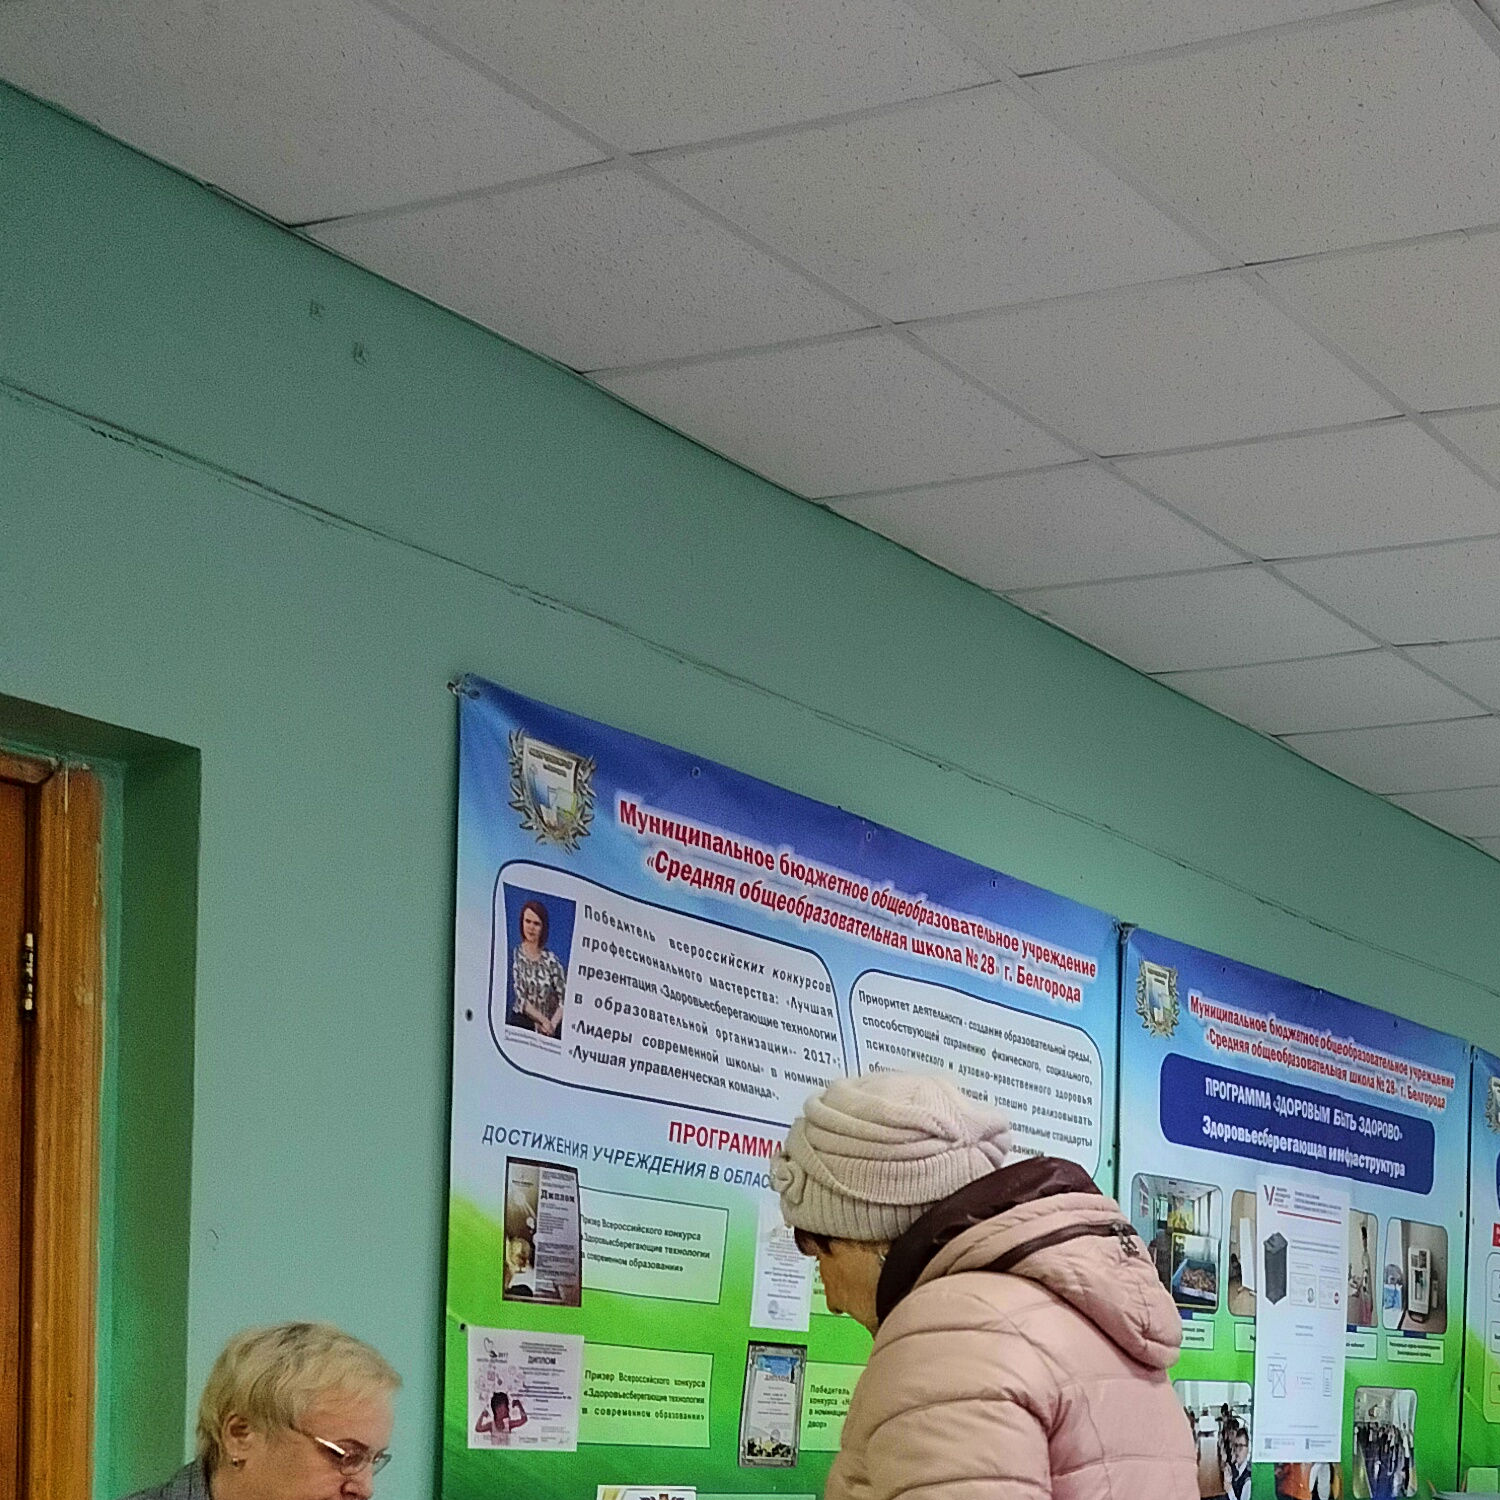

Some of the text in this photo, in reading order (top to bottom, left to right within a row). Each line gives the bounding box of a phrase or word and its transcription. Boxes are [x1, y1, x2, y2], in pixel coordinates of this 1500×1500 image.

[620, 799, 1096, 977] Муниципальное бюджетное общеобразовательное учреждение
[584, 904, 832, 993] Победитель всероссийских конкурсов
[646, 850, 735, 895] «Средняя
[739, 880, 908, 950] общеобразовательная
[911, 937, 962, 964] школа
[965, 946, 979, 970] №
[1003, 966, 1014, 982] г.
[1016, 966, 1082, 1003] Белгорода
[578, 963, 838, 1042] презентация «Здоровьесберегающие технологии
[582, 936, 834, 1018] профессионального мастерства: «Лучшая
[574, 993, 583, 1004] в
[594, 997, 708, 1035] образовательной
[858, 989, 911, 1012] Приоритет
[912, 1005, 963, 1027] деятельности
[968, 1020, 1003, 1040] создание
[1003, 1030, 1066, 1057] образовательной
[1067, 1049, 1093, 1065] среды,
[1190, 995, 1455, 1089] Муниципальное бюджетное общеобразовательное учреждение
[568, 1045, 626, 1069] «Лучшая
[629, 1060, 726, 1088] управленческая
[571, 1019, 633, 1044] «Лидеры
[642, 1035, 719, 1064] современной
[770, 1067, 778, 1078] в
[862, 1016, 1093, 1086] способствующей сохранению физического, социального,
[865, 1038, 945, 1069] психологического
[958, 1063, 1052, 1098] духовно-нравственного
[1055, 1087, 1093, 1106] здоровья
[1251, 1040, 1347, 1082] общеобразовательная
[1349, 1071, 1375, 1089] школа
[1407, 1085, 1446, 1110] Белгорода
[994, 1094, 1028, 1113] успешно
[1031, 1104, 1093, 1127] реализовывать
[1205, 1077, 1272, 1111] ПРОГРАММА
[1333, 1108, 1358, 1131] БЫТЬ
[482, 1124, 588, 1160] ДОСТИЖЕНИЯ
[592, 1146, 707, 1180] УЧРЕЖДЕНИЯ
[708, 1162, 720, 1180] В
[723, 1167, 773, 1190] ОБЛАС
[1202, 1115, 1406, 1179] Здоровьесберегающая инфраструктура
[601, 1218, 663, 1236] Всероссийского
[664, 1229, 702, 1242] конкурса
[664, 1246, 710, 1259] технологии
[584, 1369, 706, 1389] Призер Всероссийского конкурса
[810, 1384, 851, 1396] Победитель
